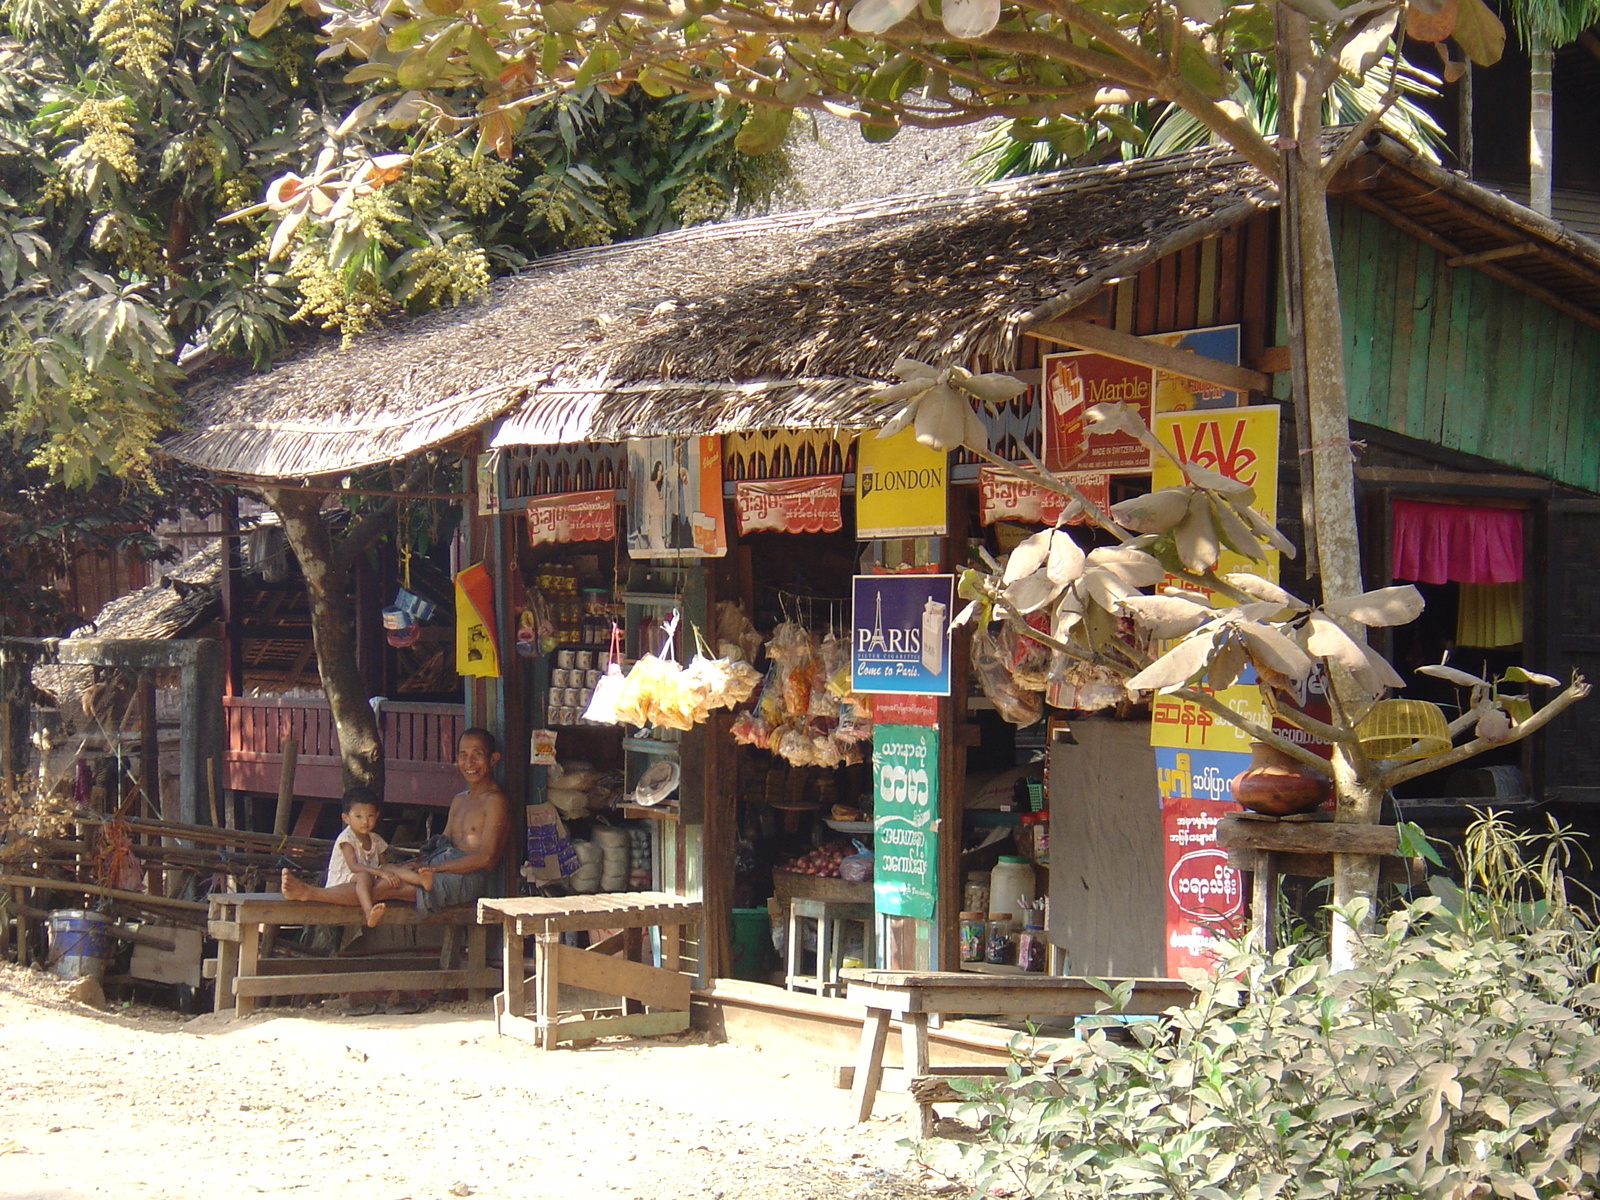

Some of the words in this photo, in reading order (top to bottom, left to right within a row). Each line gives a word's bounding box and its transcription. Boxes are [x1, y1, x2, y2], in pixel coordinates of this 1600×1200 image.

[1088, 376, 1148, 402] Marble
[1091, 447, 1106, 456] MADE
[1106, 447, 1112, 455] IN
[1112, 445, 1146, 455] SWITZERLAND
[1171, 418, 1259, 488] VeVe
[874, 468, 942, 491] LONDON
[857, 628, 921, 654] PARIS
[857, 661, 882, 676] Come
[884, 665, 893, 676] to
